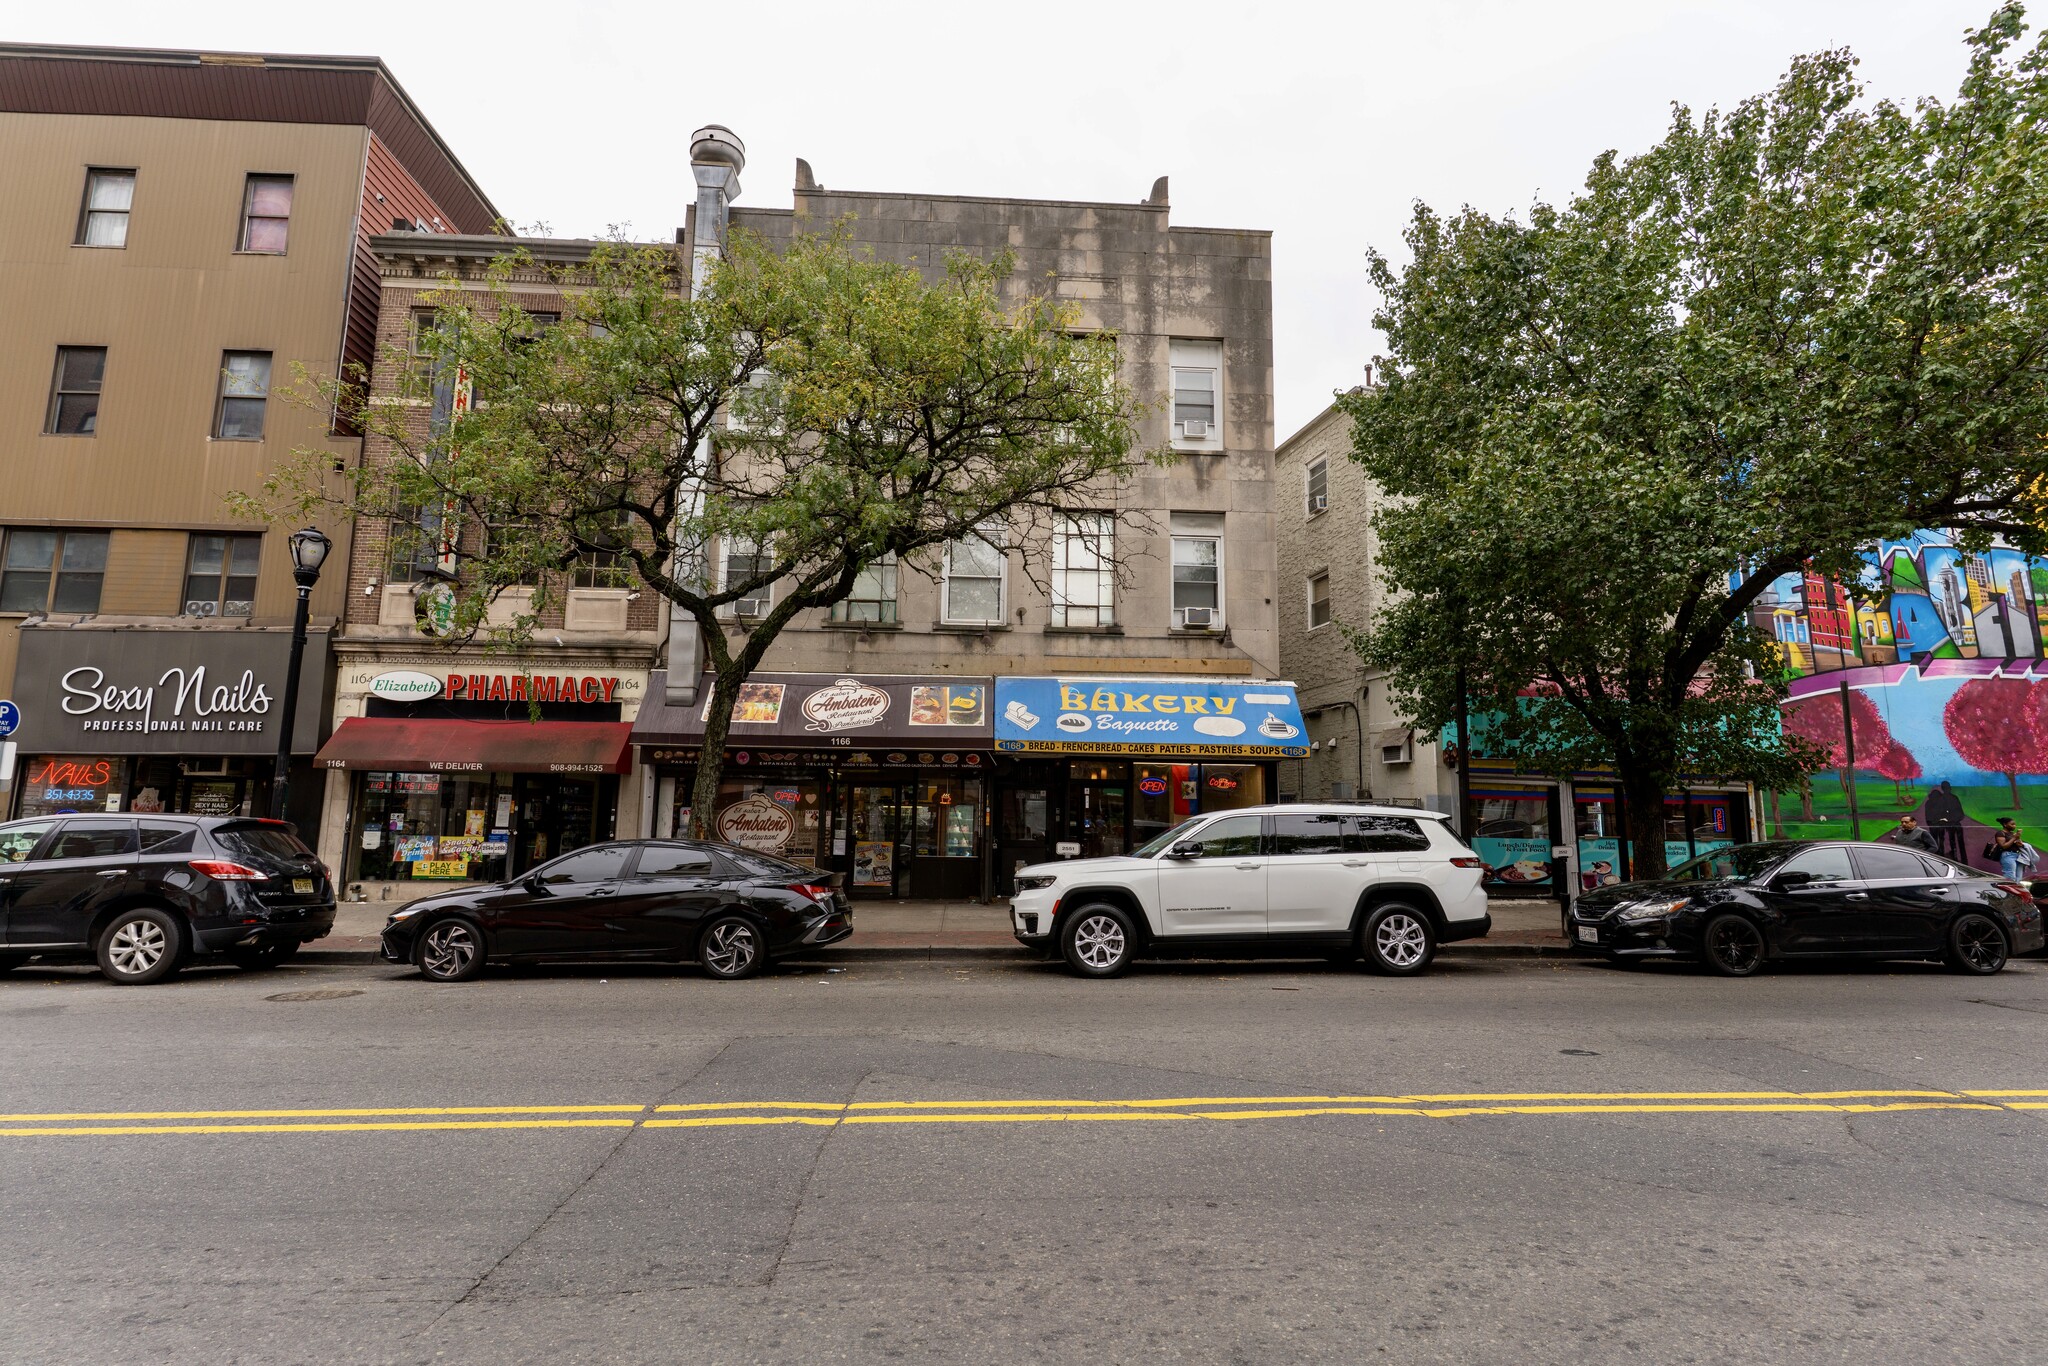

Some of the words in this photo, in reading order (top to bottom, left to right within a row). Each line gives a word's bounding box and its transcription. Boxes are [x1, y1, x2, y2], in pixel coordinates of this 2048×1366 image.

[373, 680, 438, 693] Elizabeth
[445, 674, 619, 703] PHARMACY
[61, 666, 153, 734] Sexy
[159, 665, 273, 717] Nails
[811, 694, 882, 713] Ambateño
[1060, 683, 1238, 715] BAKERY
[826, 707, 875, 720] Restaurant
[192, 720, 223, 731] NAIL
[228, 720, 263, 732] CARE
[1095, 714, 1179, 737] Baguette
[830, 737, 851, 745] 1166
[1001, 741, 1021, 750] 1168
[1028, 742, 1055, 751] BREAD
[1062, 743, 1094, 751] FRENCH
[1095, 743, 1122, 752] BREAD
[1128, 744, 1155, 753] CAKES
[1159, 745, 1191, 754] PATIES
[1199, 745, 1243, 755] PASTRIES
[1250, 746, 1280, 755] SOUPS
[1284, 747, 1303, 756] 1168
[327, 759, 346, 768] 1164
[445, 762, 483, 771] DELIVER
[550, 763, 603, 772] 908-994-1525
[32, 761, 110, 786] NAILS
[1140, 781, 1166, 792] OPEN
[44, 788, 95, 801] 351-4335
[774, 791, 800, 802] OPEN
[725, 813, 788, 832] Ambateño
[737, 832, 779, 841] Restaurant
[414, 840, 434, 849] Cold
[450, 845, 482, 854] Candy!
[1498, 841, 1547, 849] Lunch/Dinner
[401, 847, 434, 857] Drinks!
[429, 861, 451, 869] PLAY
